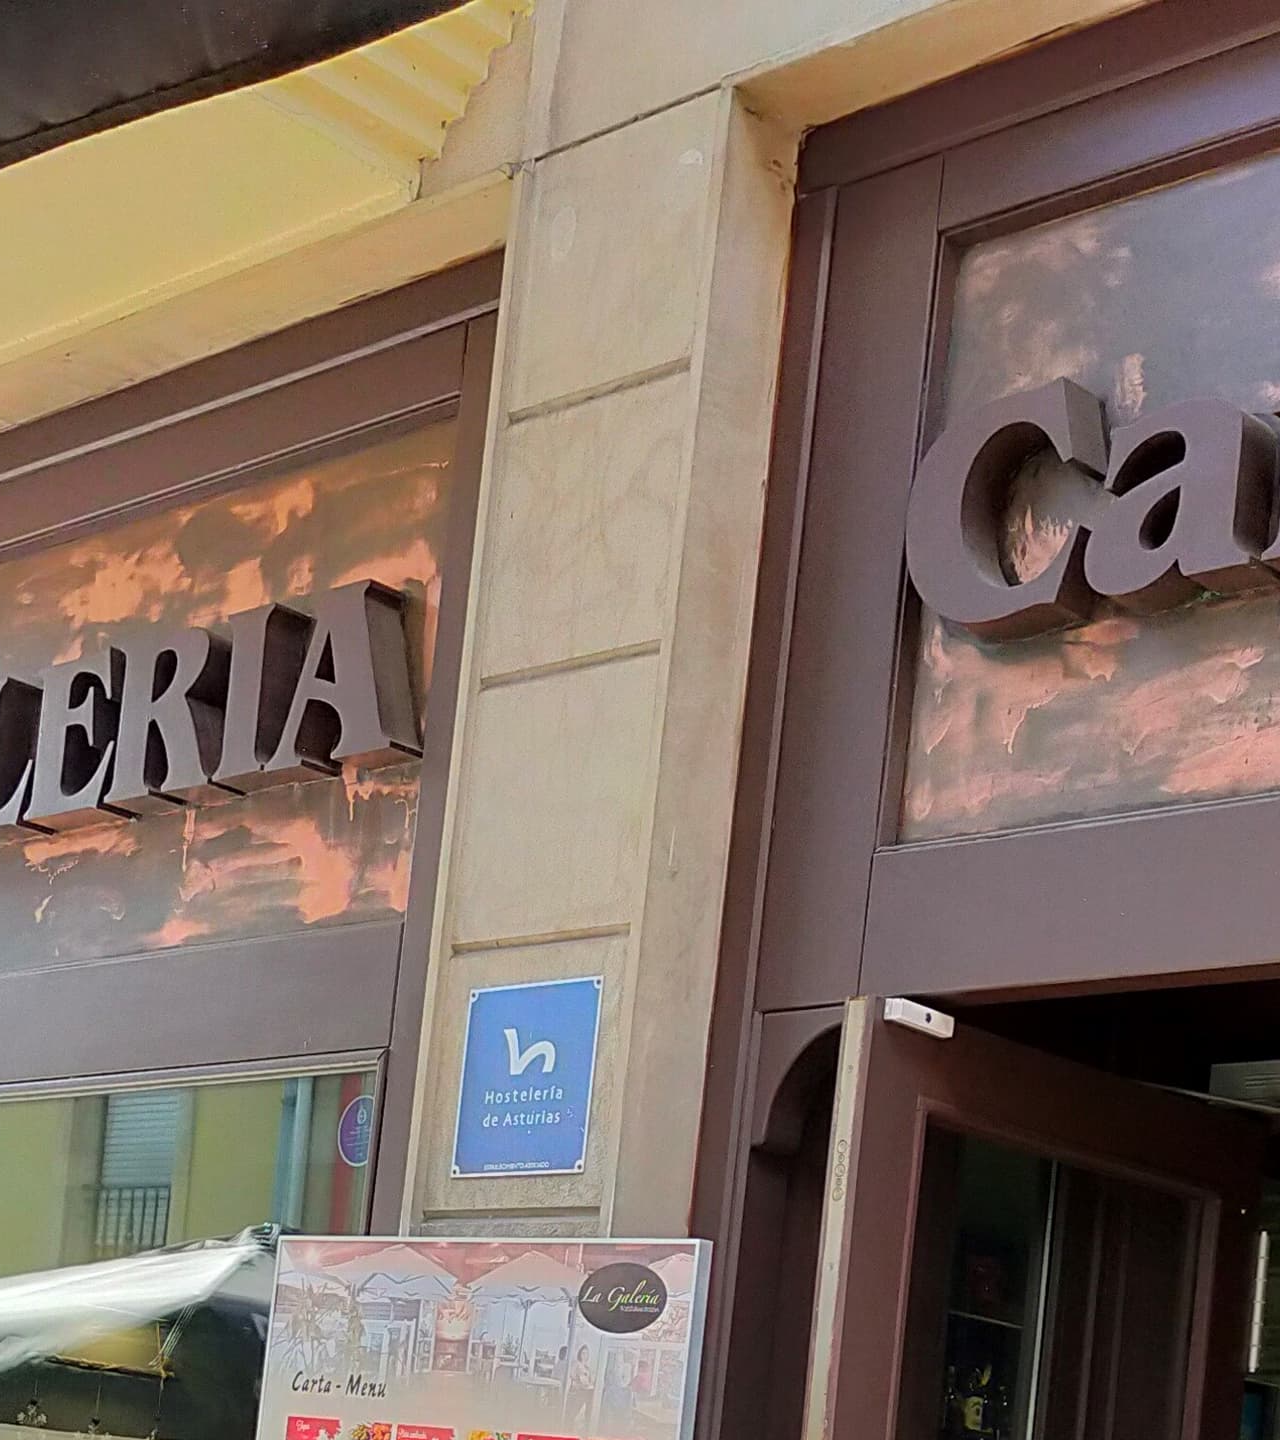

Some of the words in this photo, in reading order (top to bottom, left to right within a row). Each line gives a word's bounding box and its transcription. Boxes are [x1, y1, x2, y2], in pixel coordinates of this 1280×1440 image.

[484, 1085, 564, 1105] Hostelería
[482, 1113, 499, 1128] de
[502, 1110, 561, 1127] Asturias
[291, 1370, 331, 1394] Carta
[344, 1378, 388, 1400] Menu
